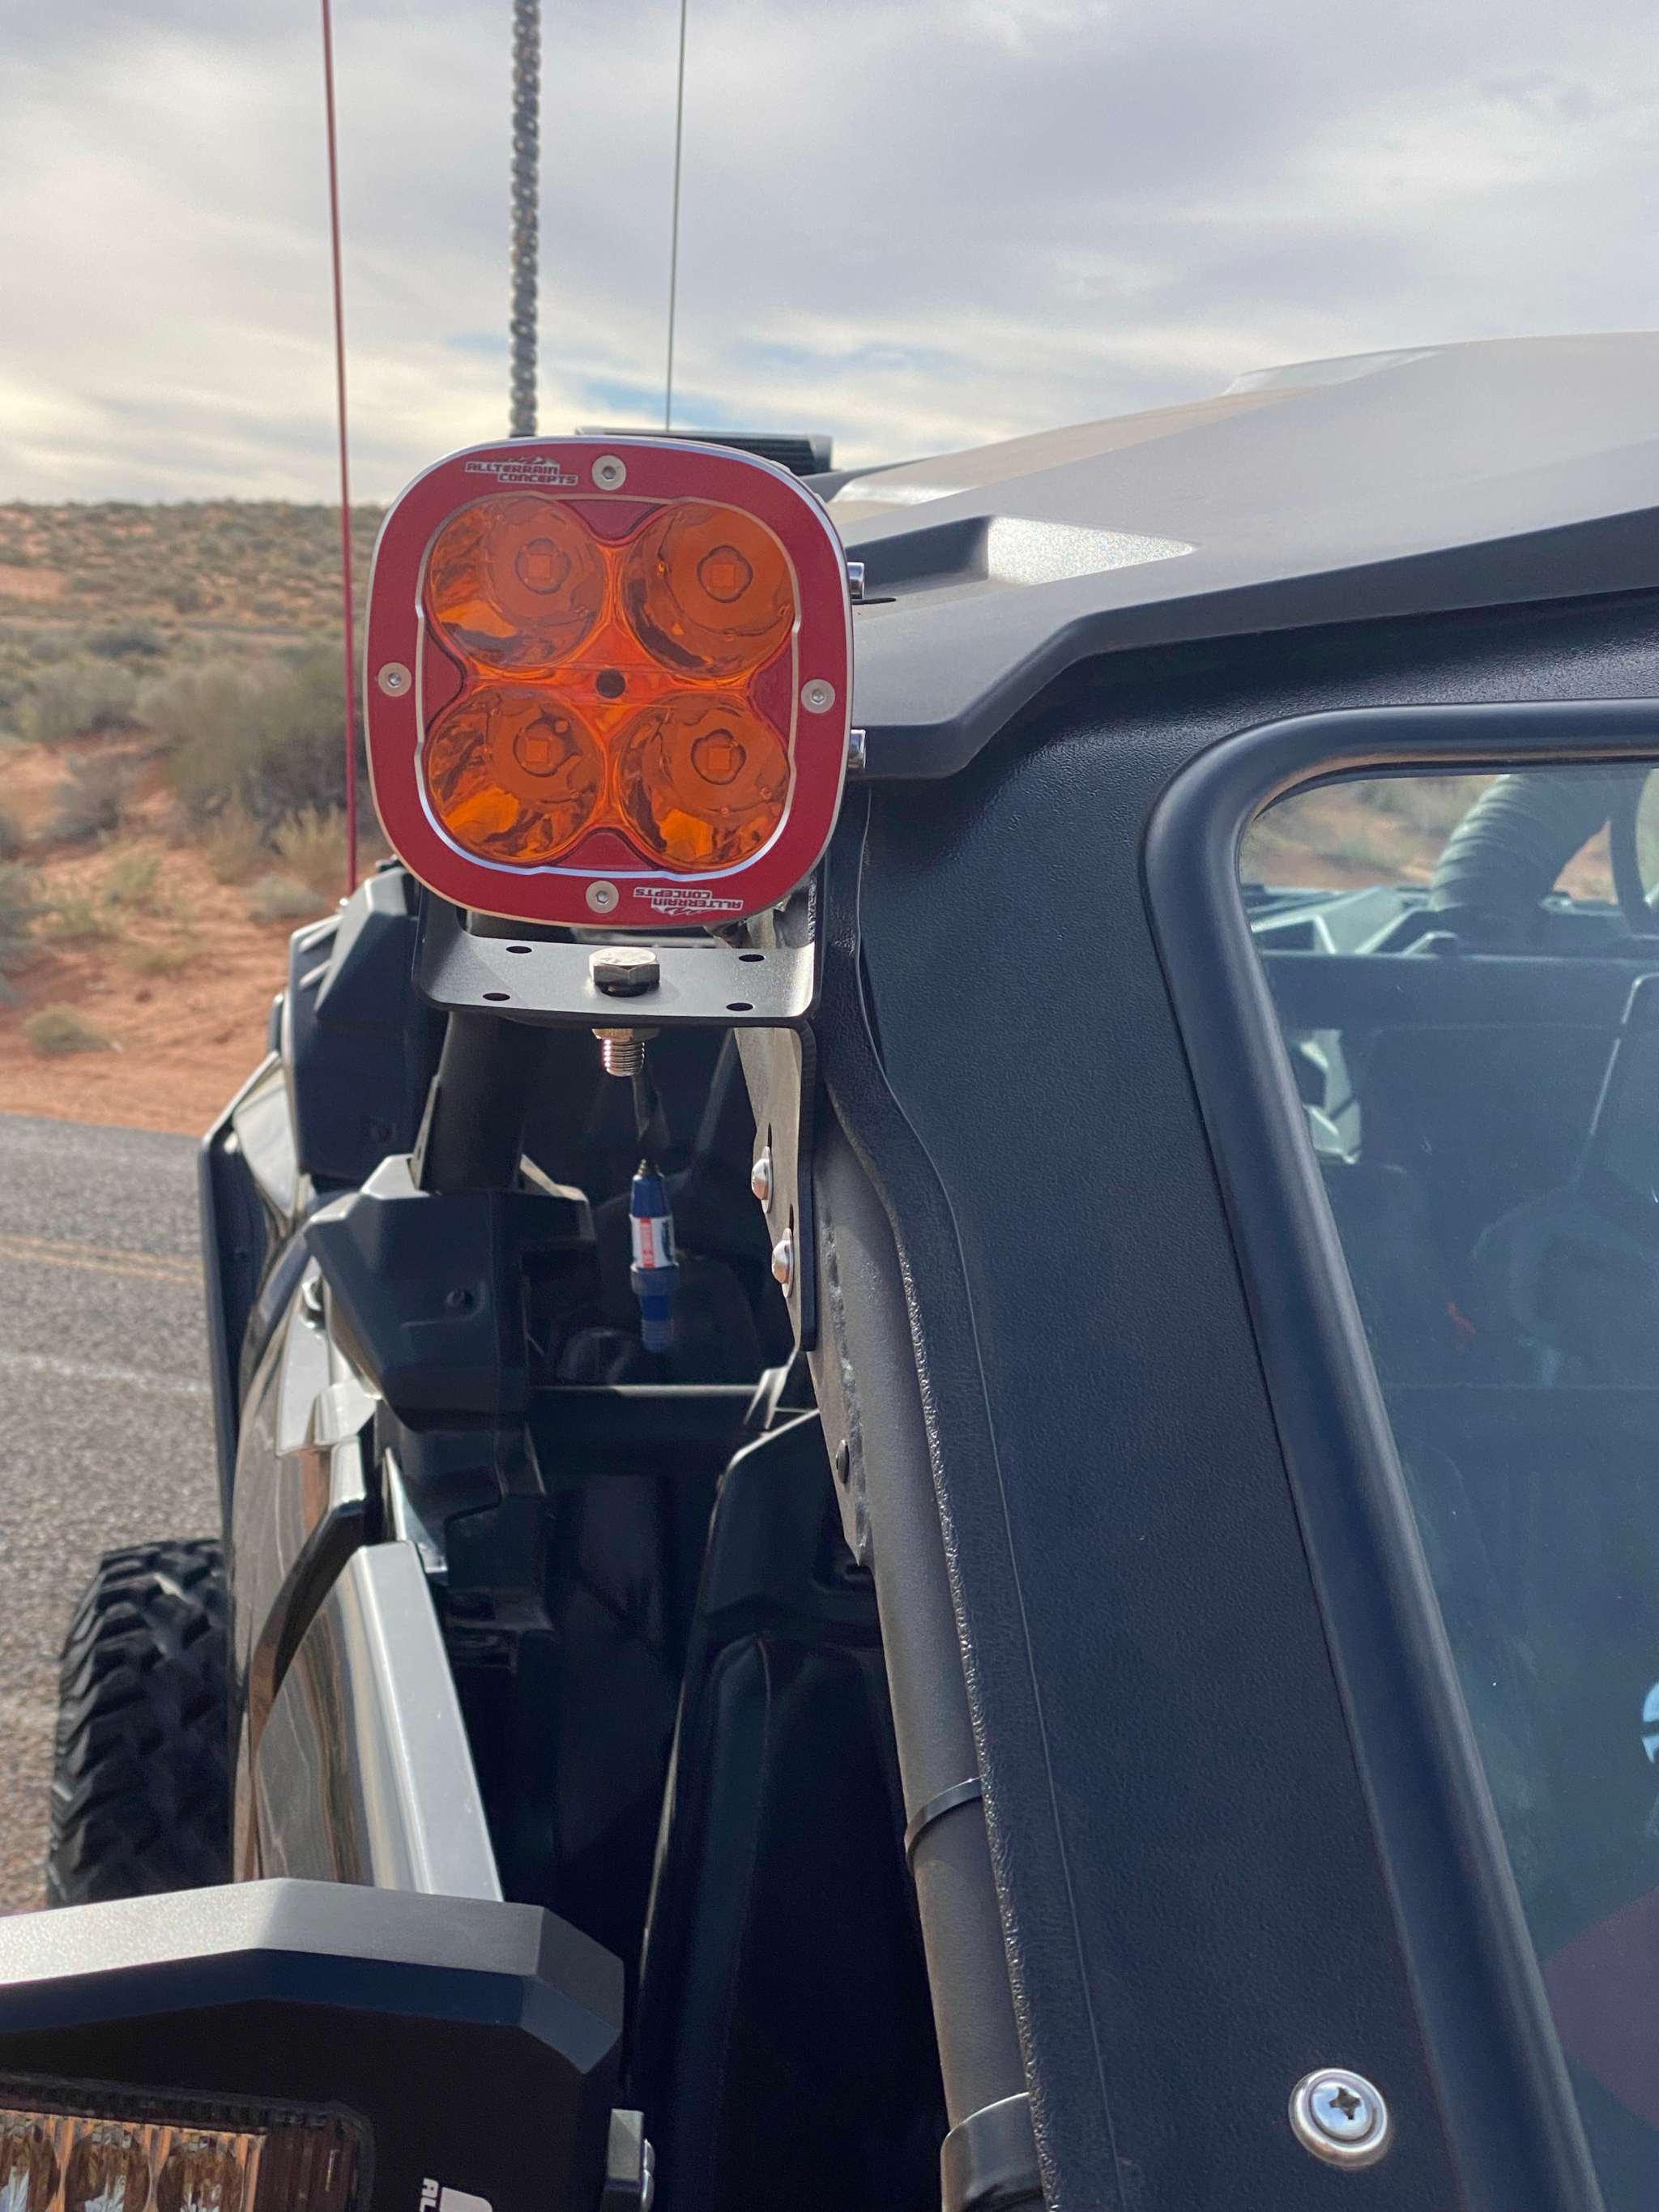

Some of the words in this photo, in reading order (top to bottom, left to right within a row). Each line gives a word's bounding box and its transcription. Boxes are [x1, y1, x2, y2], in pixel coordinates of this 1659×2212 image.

[466, 462, 558, 475] ALLTERRAIN
[498, 472, 577, 485] CONCEPTS
[634, 888, 711, 899] CONCEPTS
[653, 897, 742, 909] ALLTERRAIN
